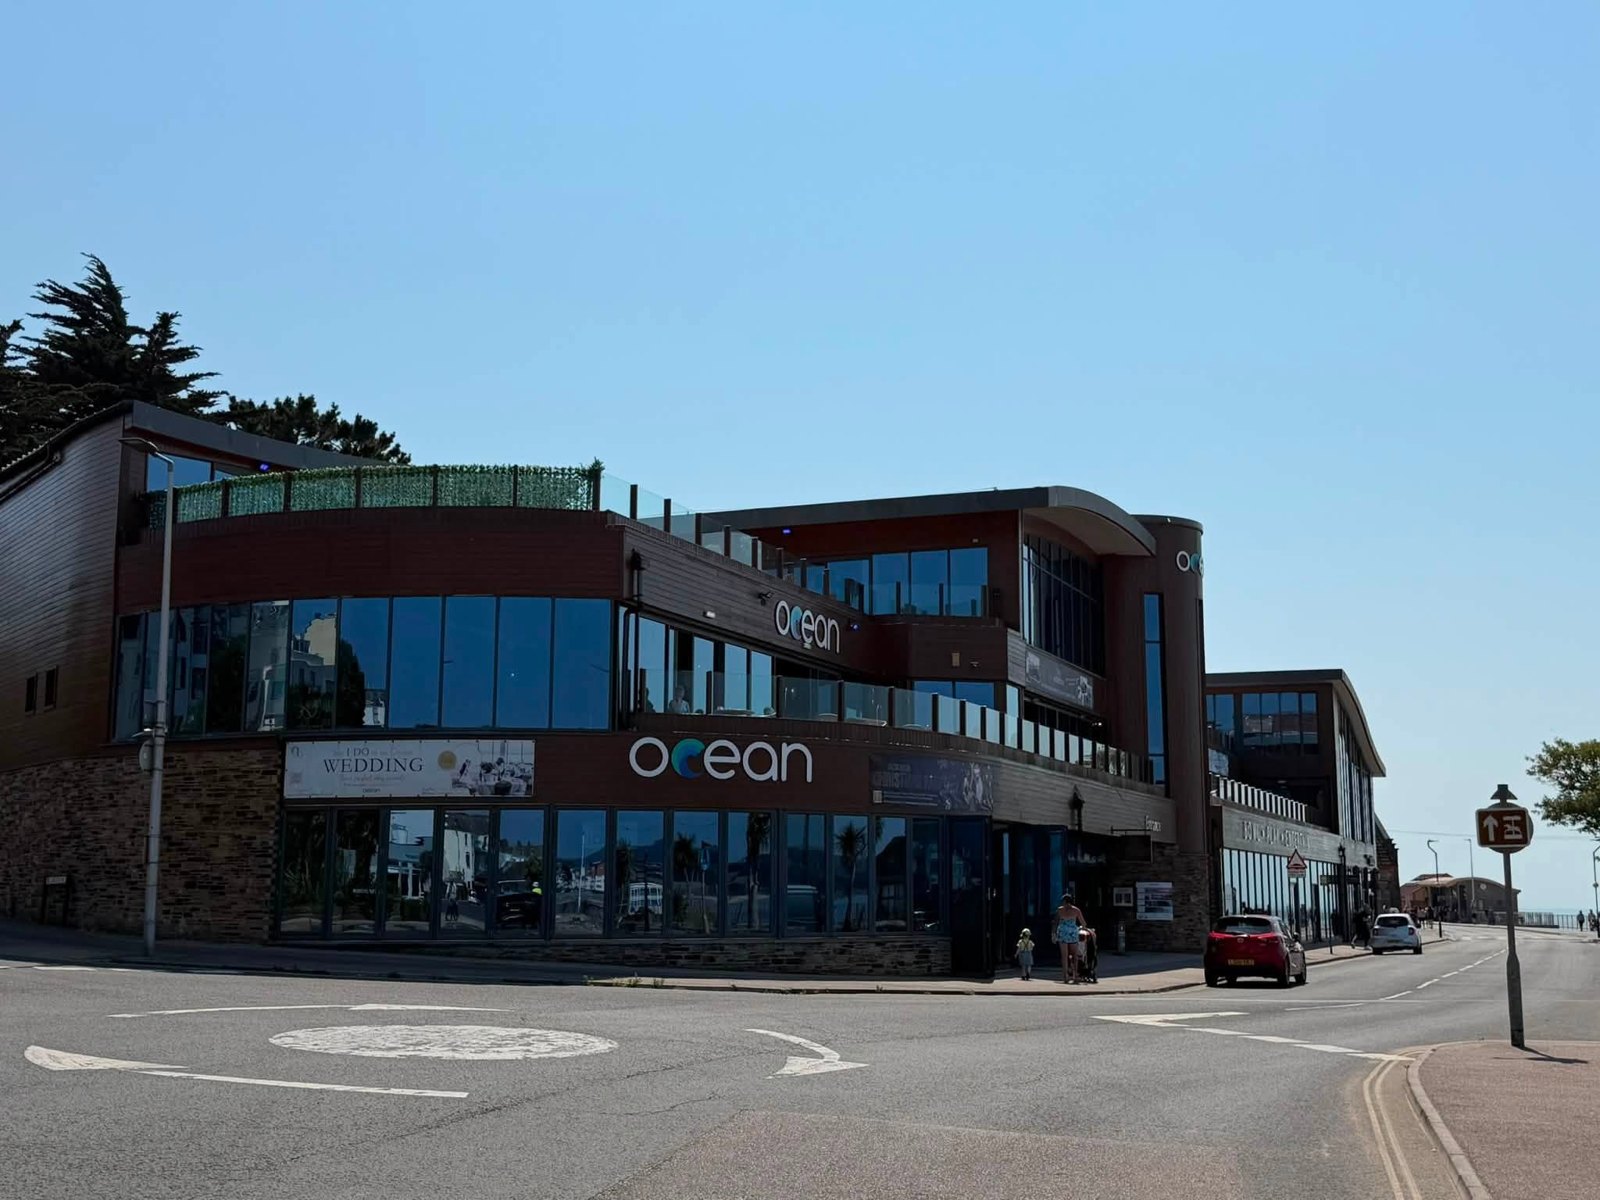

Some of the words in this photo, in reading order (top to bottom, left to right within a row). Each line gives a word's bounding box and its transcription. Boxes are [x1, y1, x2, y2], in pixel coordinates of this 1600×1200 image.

[776, 600, 840, 654] ocean
[323, 757, 424, 773] WEDDING
[346, 746, 350, 757] I
[353, 747, 370, 757] DO
[629, 736, 813, 783] ocean
